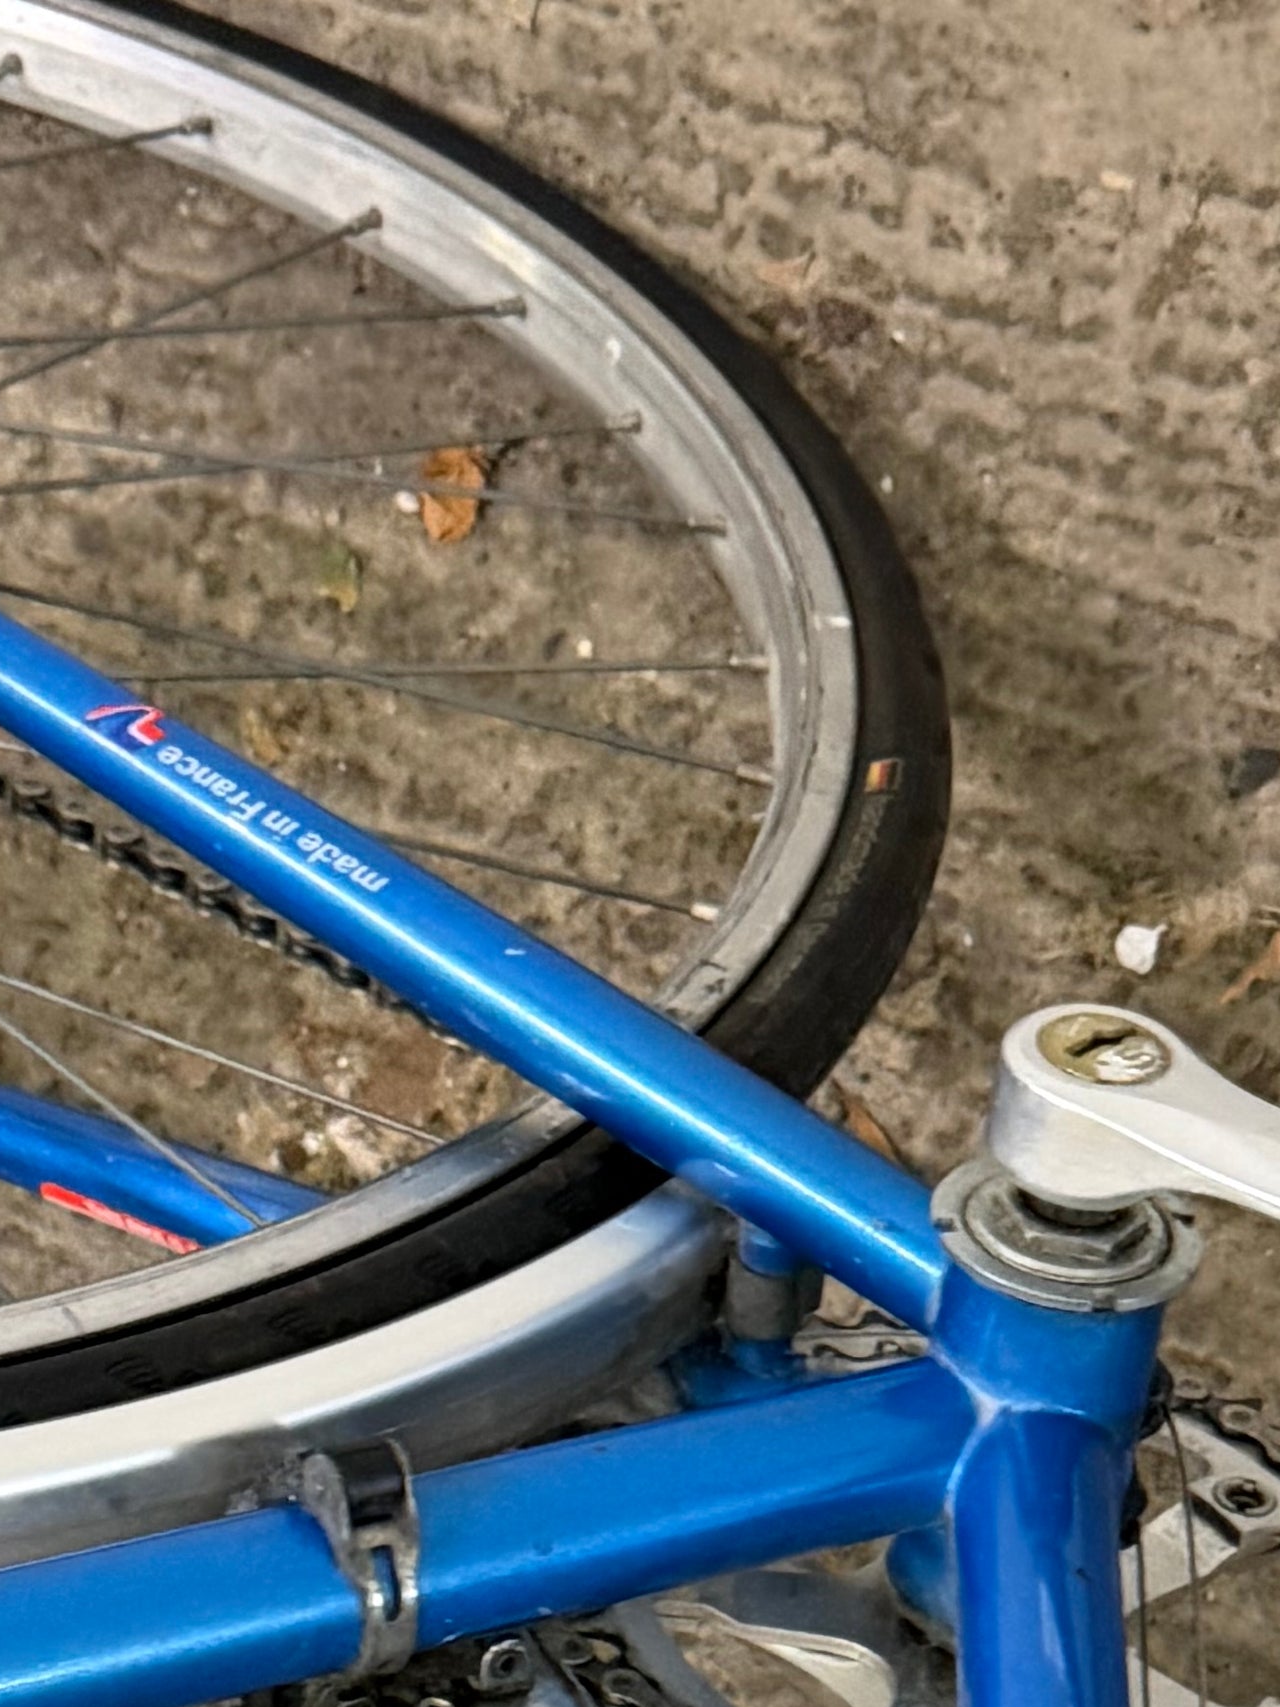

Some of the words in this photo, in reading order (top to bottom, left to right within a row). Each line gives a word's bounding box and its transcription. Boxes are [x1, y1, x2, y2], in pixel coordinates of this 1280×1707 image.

[158, 745, 265, 822] France
[261, 810, 300, 840] in
[297, 831, 389, 892] made
